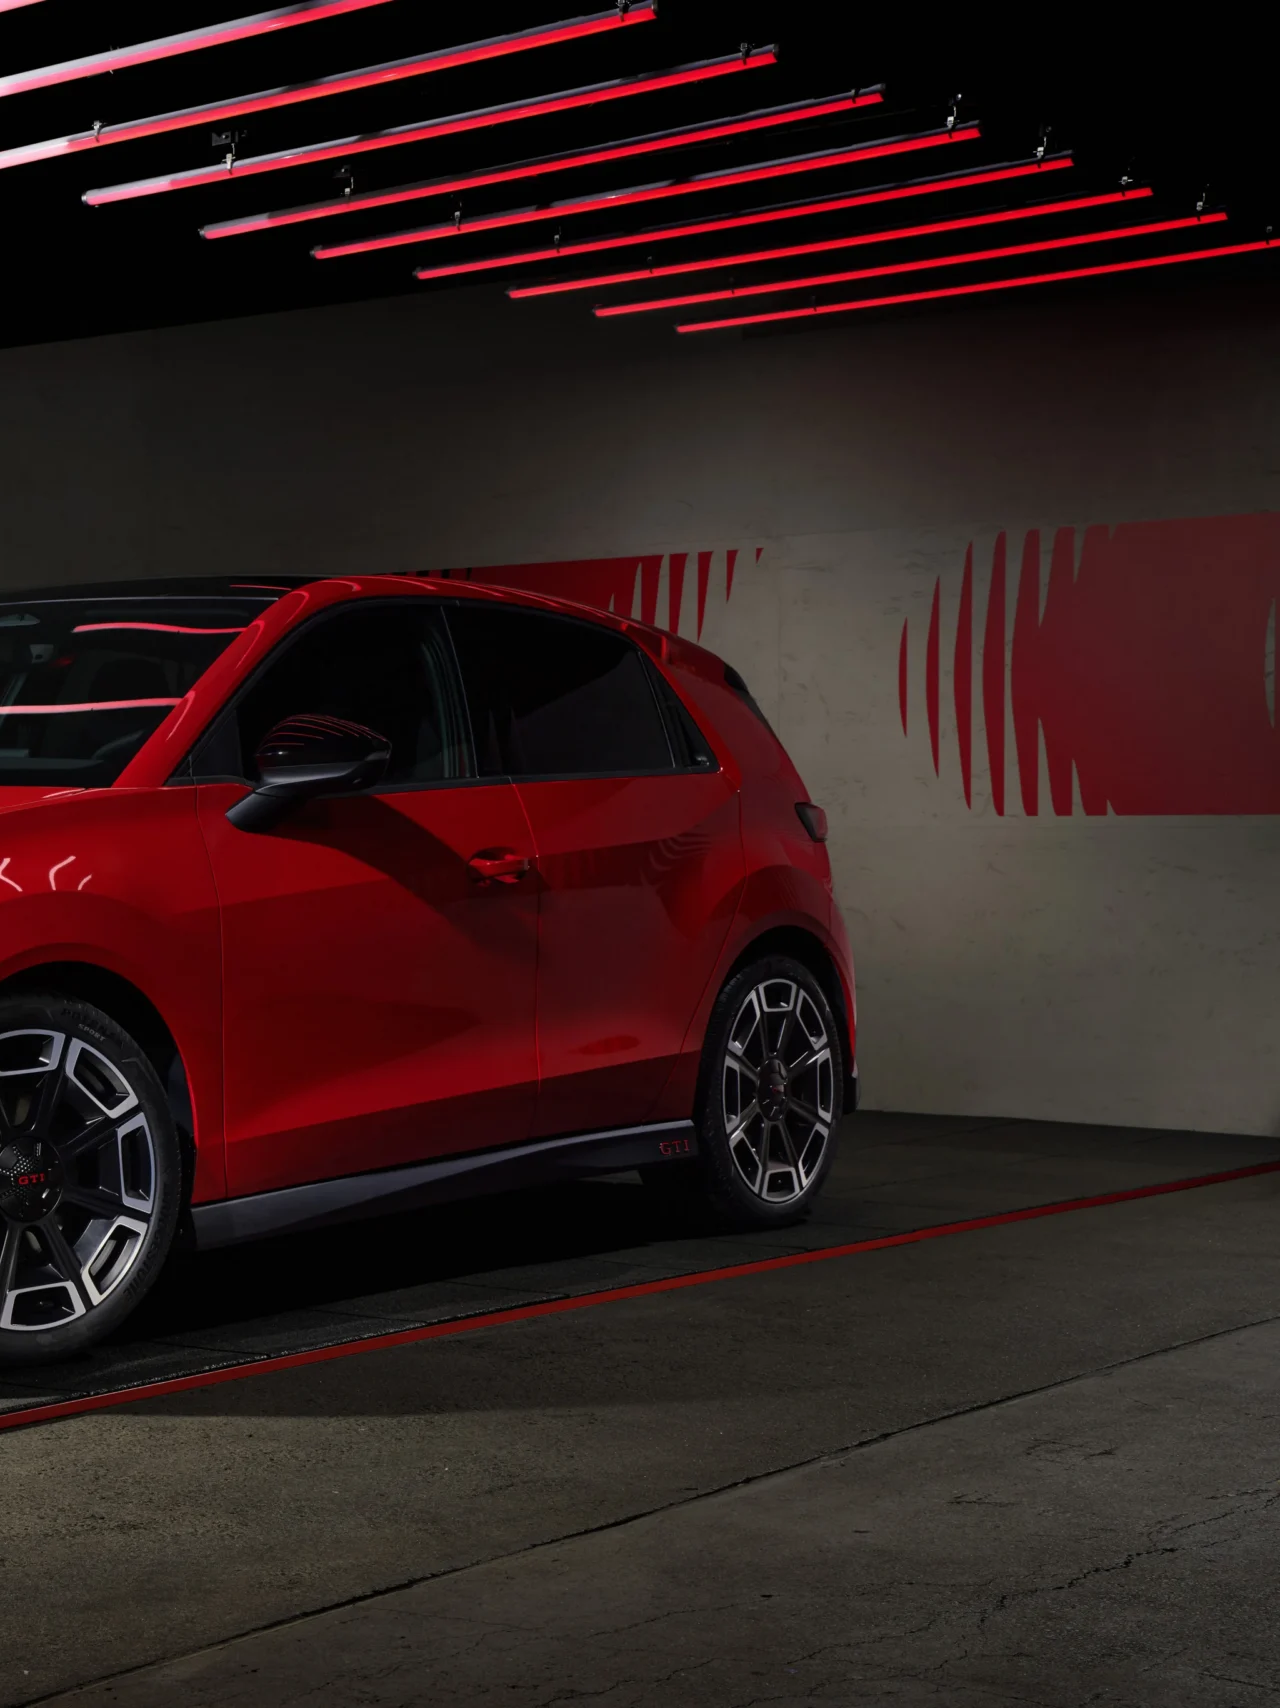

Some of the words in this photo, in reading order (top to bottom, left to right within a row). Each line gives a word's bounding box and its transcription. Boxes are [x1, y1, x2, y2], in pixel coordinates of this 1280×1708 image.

[78, 1023, 106, 1042] SPORT
[660, 1139, 689, 1155] GTI
[18, 1172, 45, 1185] GTI
